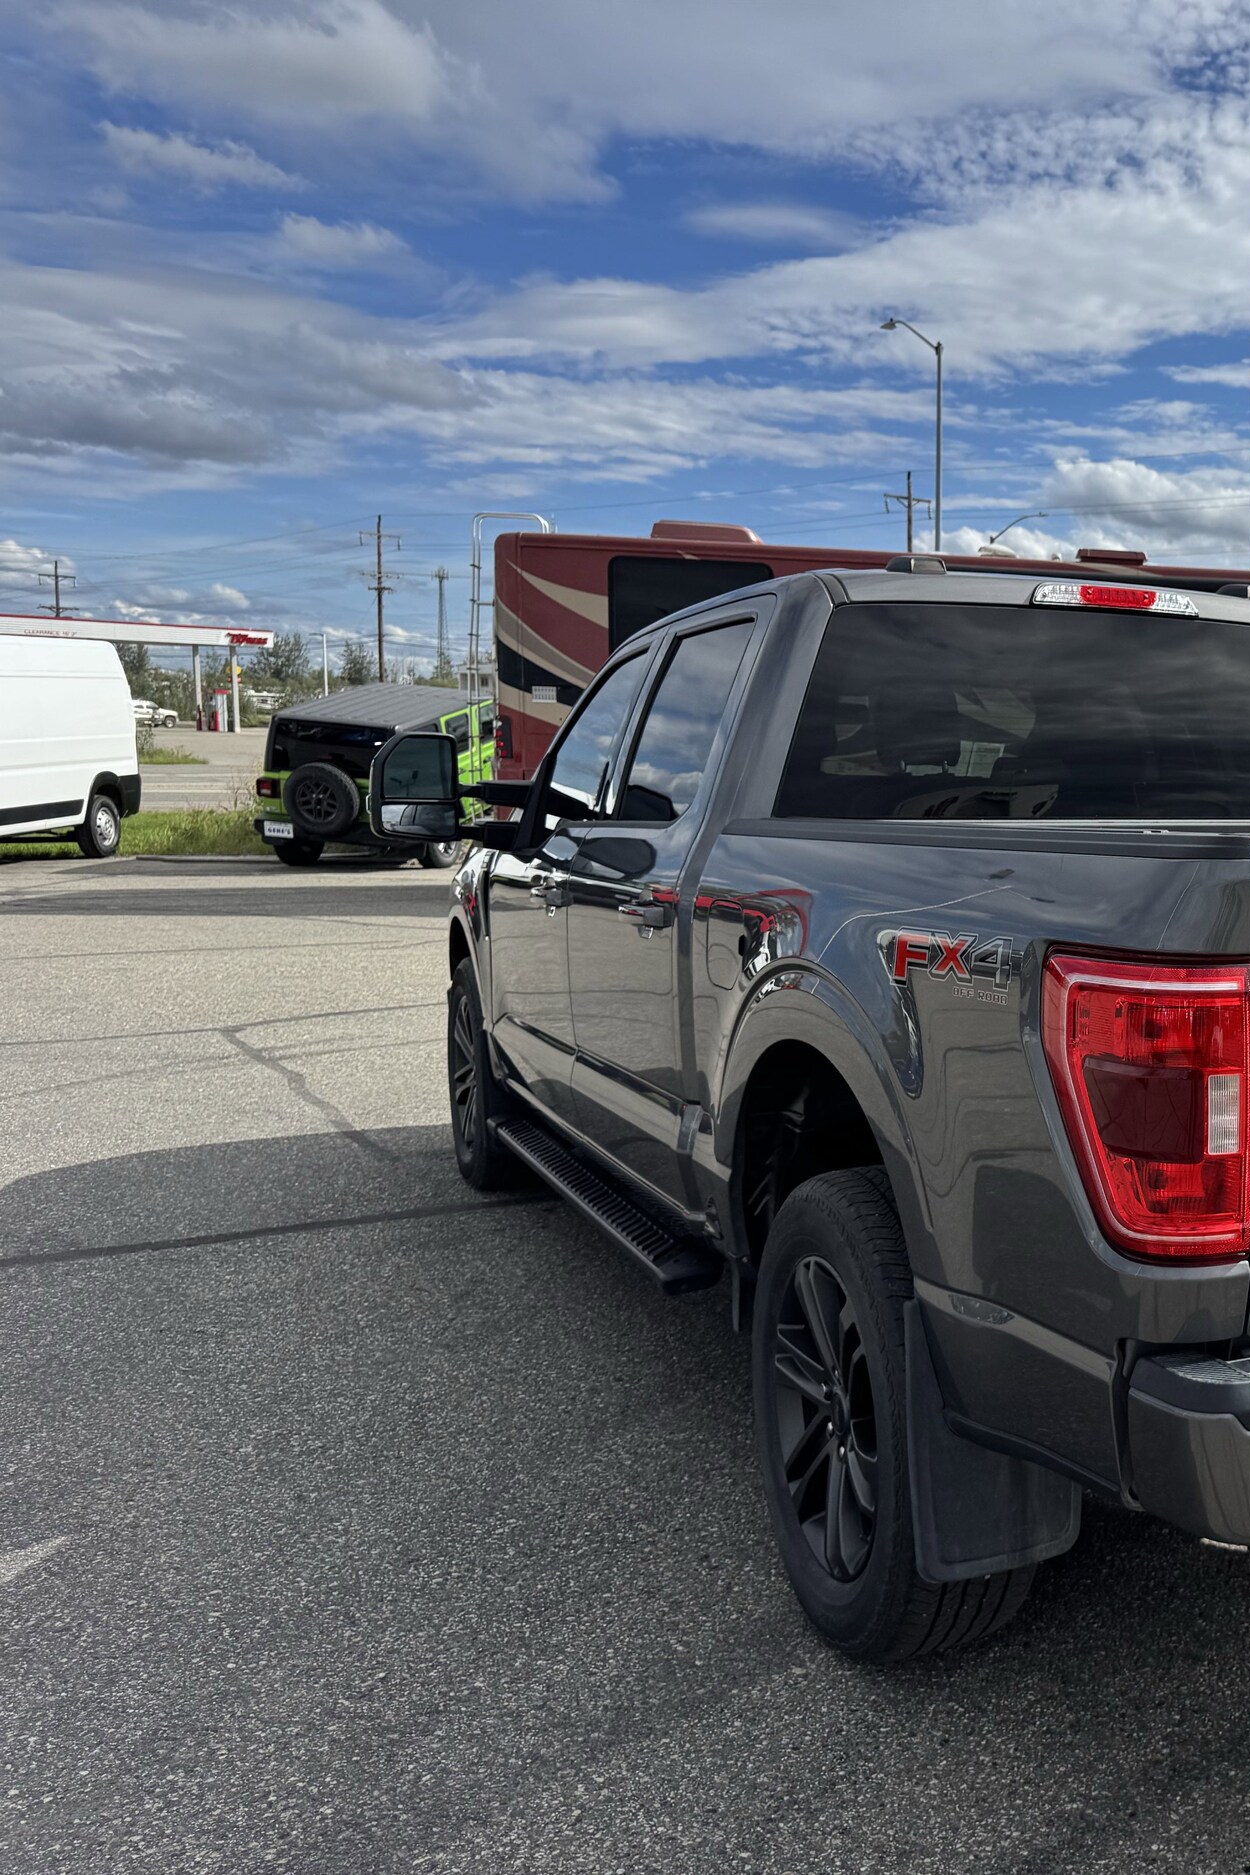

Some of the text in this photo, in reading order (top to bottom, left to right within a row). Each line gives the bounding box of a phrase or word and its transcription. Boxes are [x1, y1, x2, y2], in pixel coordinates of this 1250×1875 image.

[893, 926, 1014, 991] FX4
[953, 986, 1008, 1005] OFF ROAD
